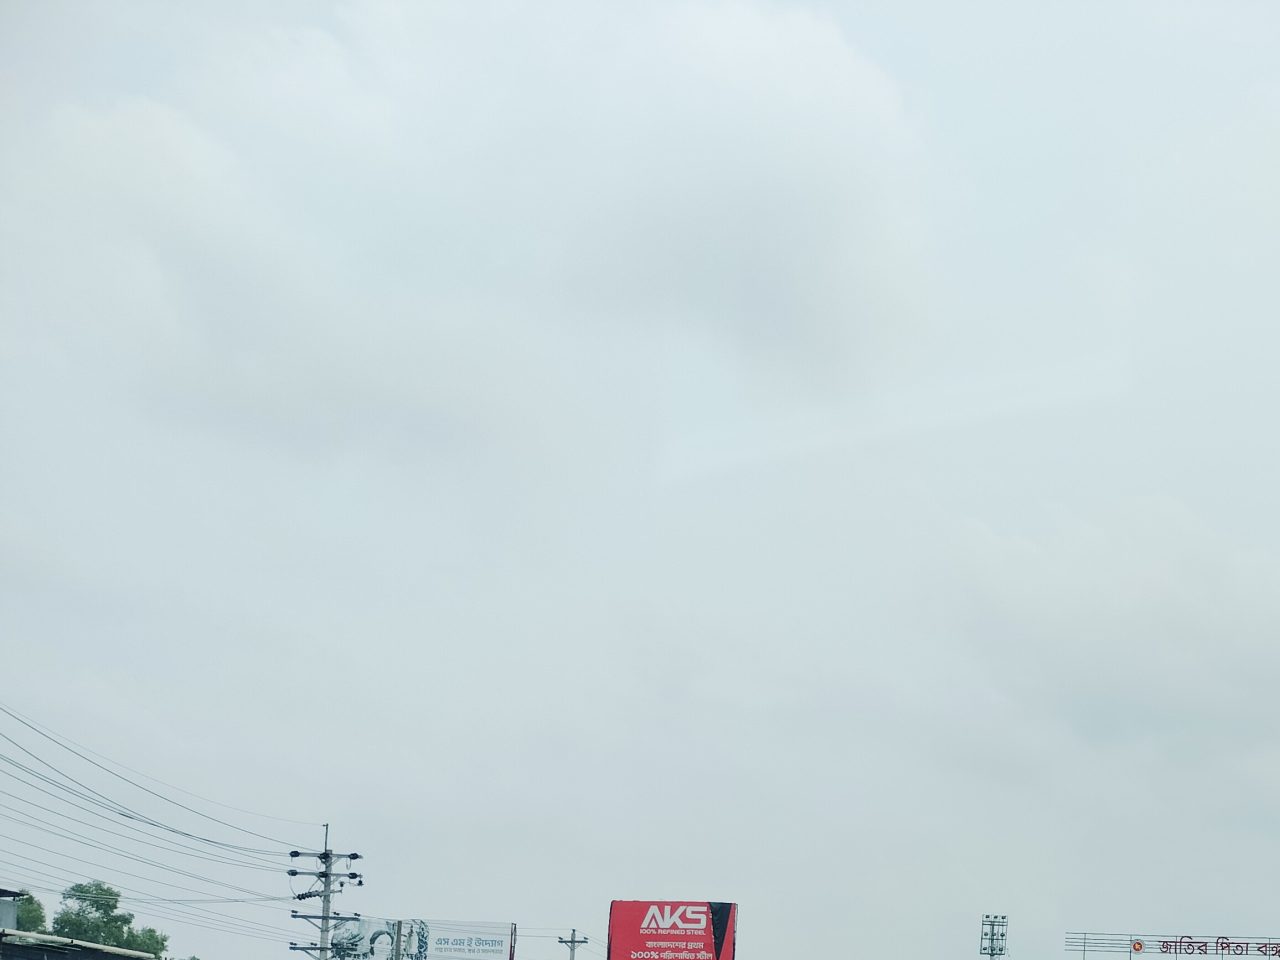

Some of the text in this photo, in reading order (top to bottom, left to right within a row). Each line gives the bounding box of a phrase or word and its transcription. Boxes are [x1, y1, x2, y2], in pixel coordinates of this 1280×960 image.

[640, 905, 707, 929] AKS
[1158, 936, 1208, 955] জাতির
[1216, 937, 1250, 955] পিতা
